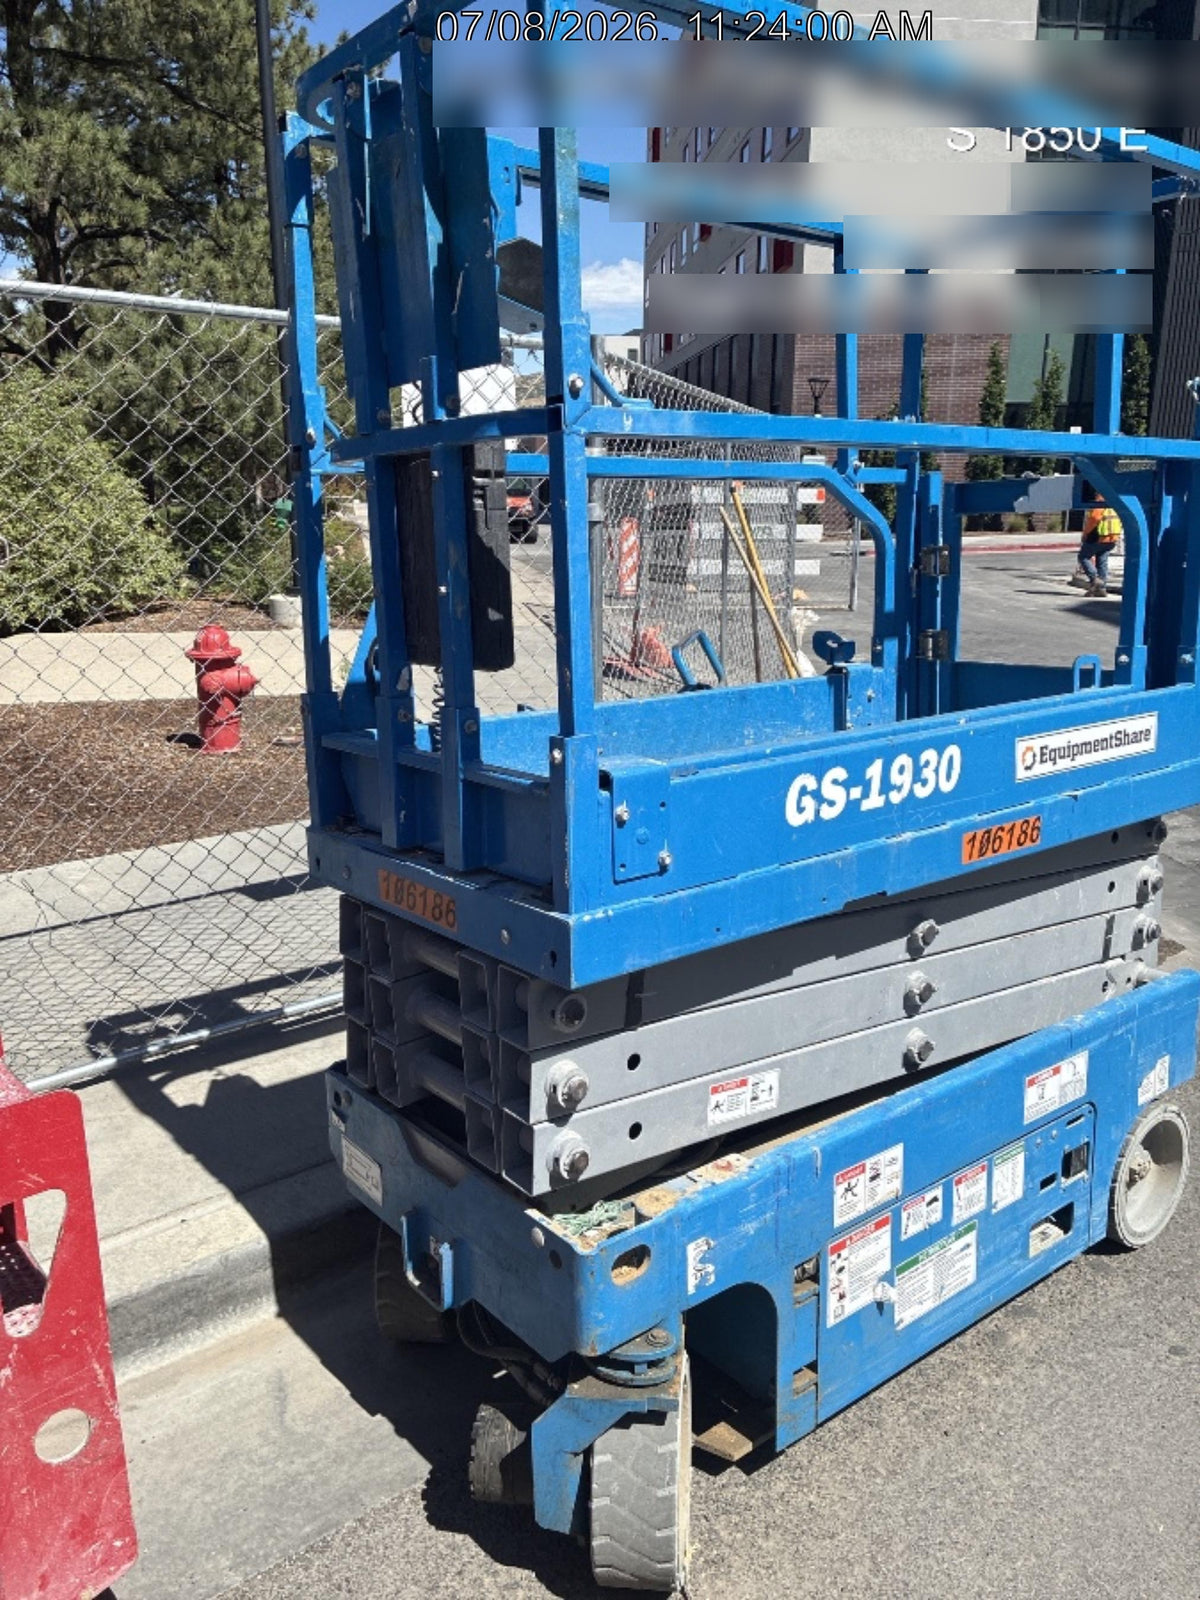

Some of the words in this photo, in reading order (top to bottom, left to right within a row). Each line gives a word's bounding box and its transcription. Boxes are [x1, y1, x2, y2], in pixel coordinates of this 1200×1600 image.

[1039, 728, 1152, 766] EquipmentShare
[785, 744, 961, 827] GS-1930
[966, 815, 1041, 861] 106186
[379, 871, 456, 929] 106186
